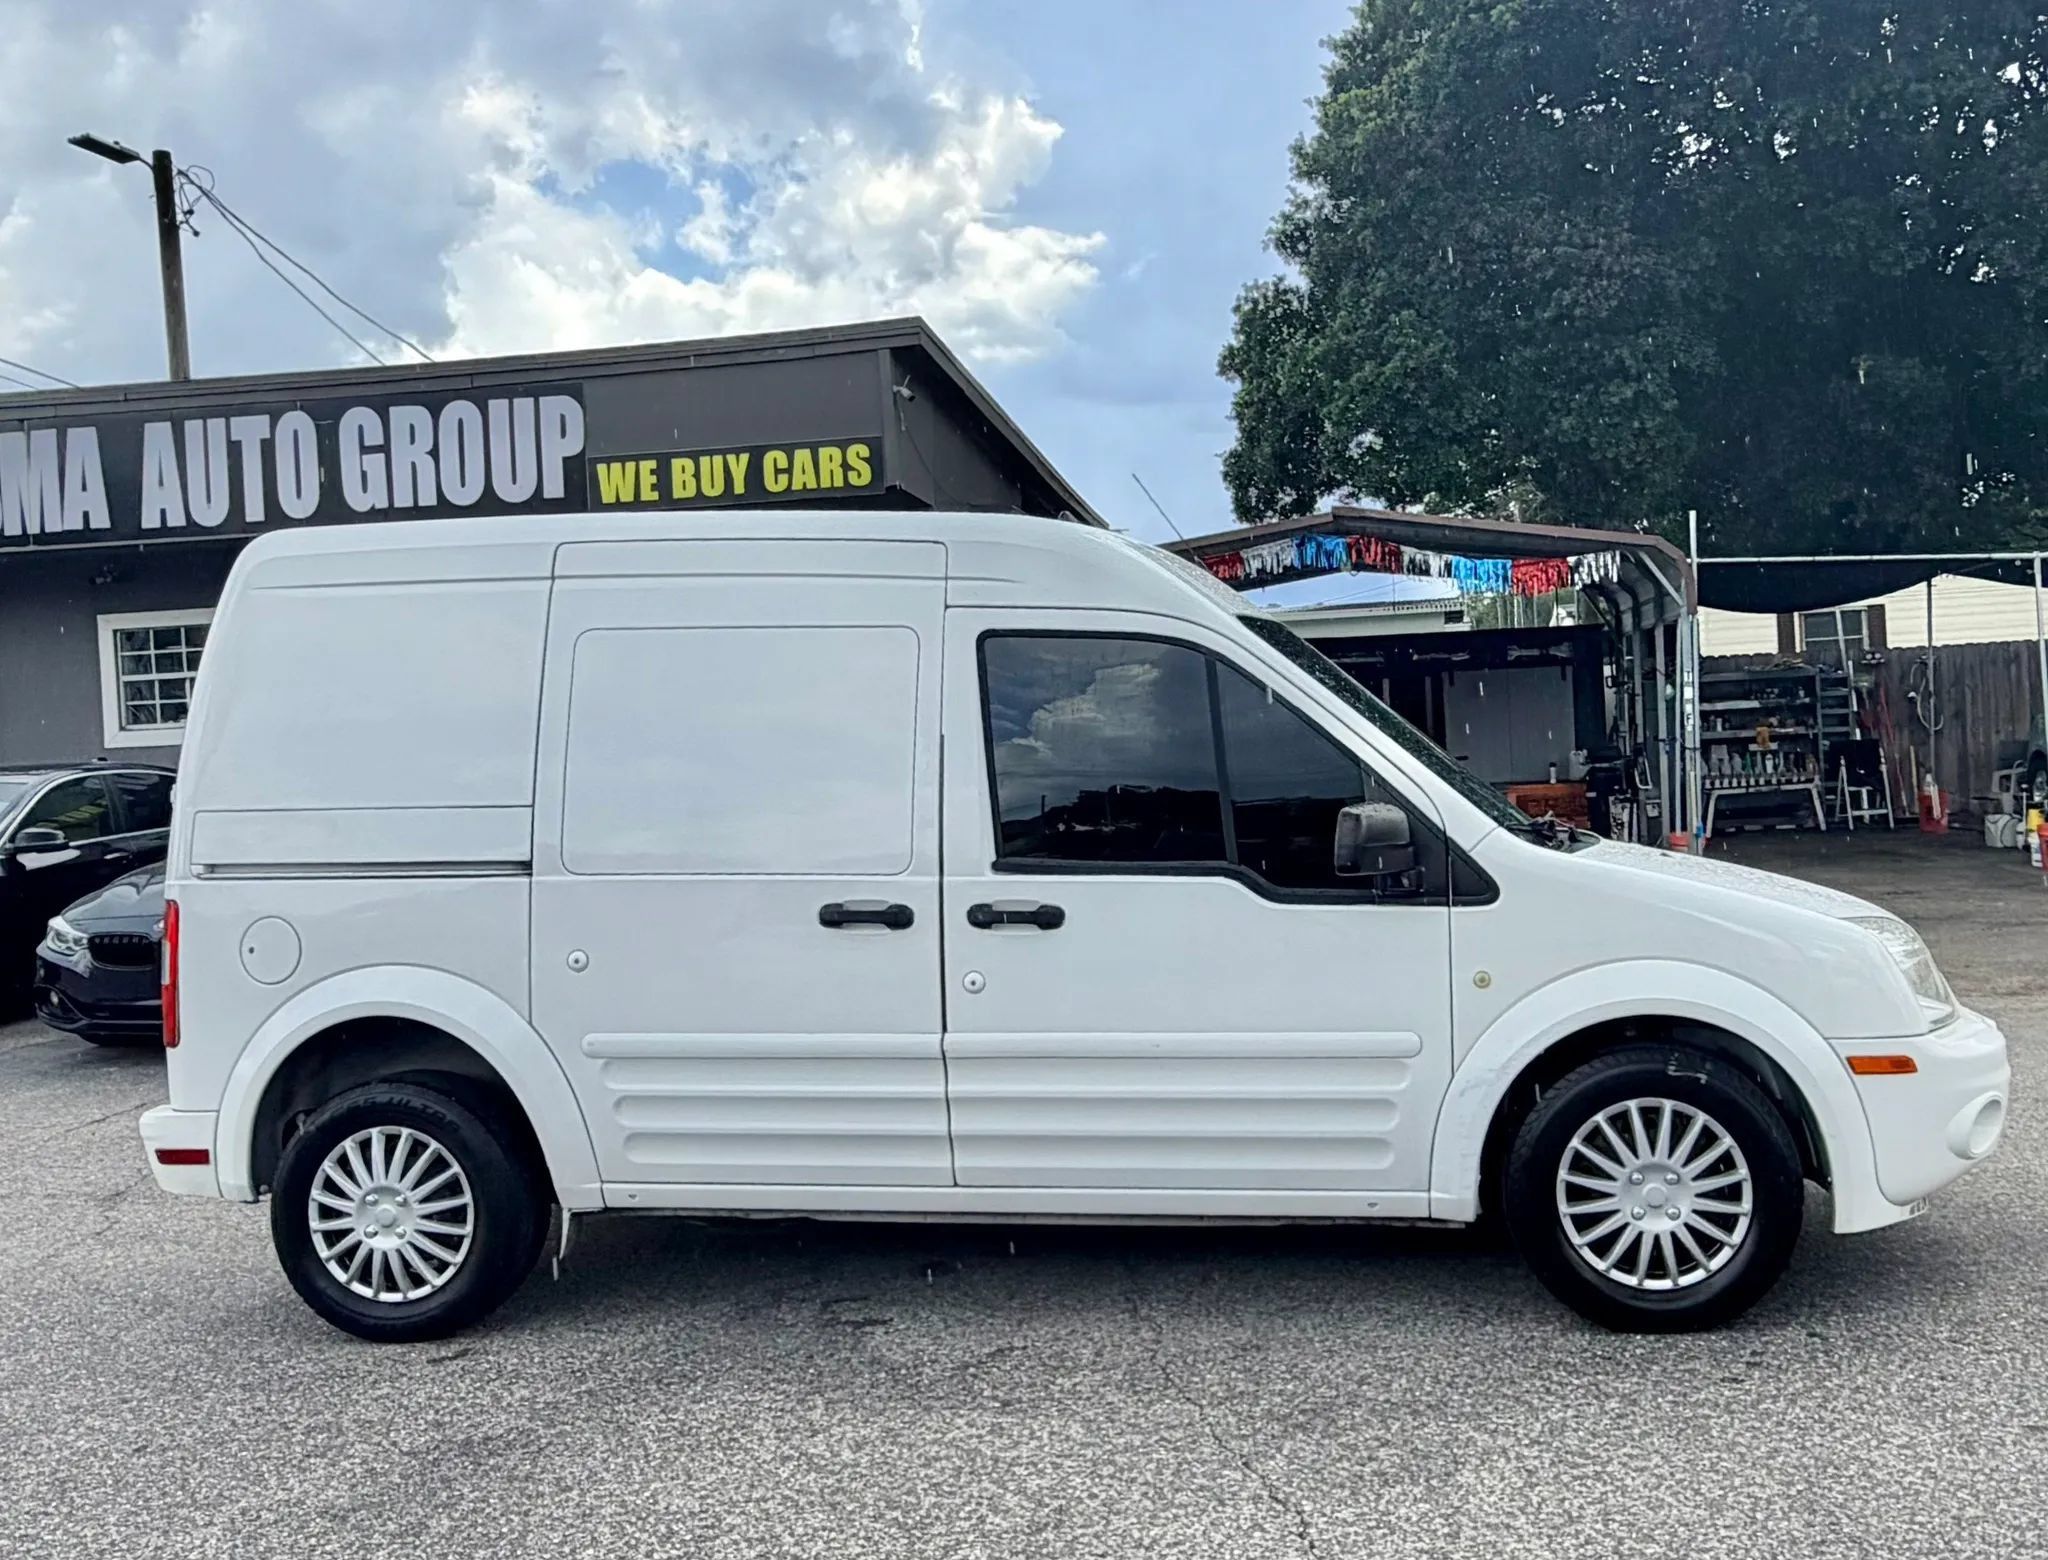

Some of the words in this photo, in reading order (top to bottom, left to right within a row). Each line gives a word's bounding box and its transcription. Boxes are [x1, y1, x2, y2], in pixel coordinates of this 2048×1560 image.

[0, 426, 111, 536] MA
[141, 410, 320, 529] AUTO
[338, 395, 585, 513] GROUP
[597, 460, 659, 504] WE
[671, 453, 750, 499] BUY
[763, 443, 873, 493] CARS
